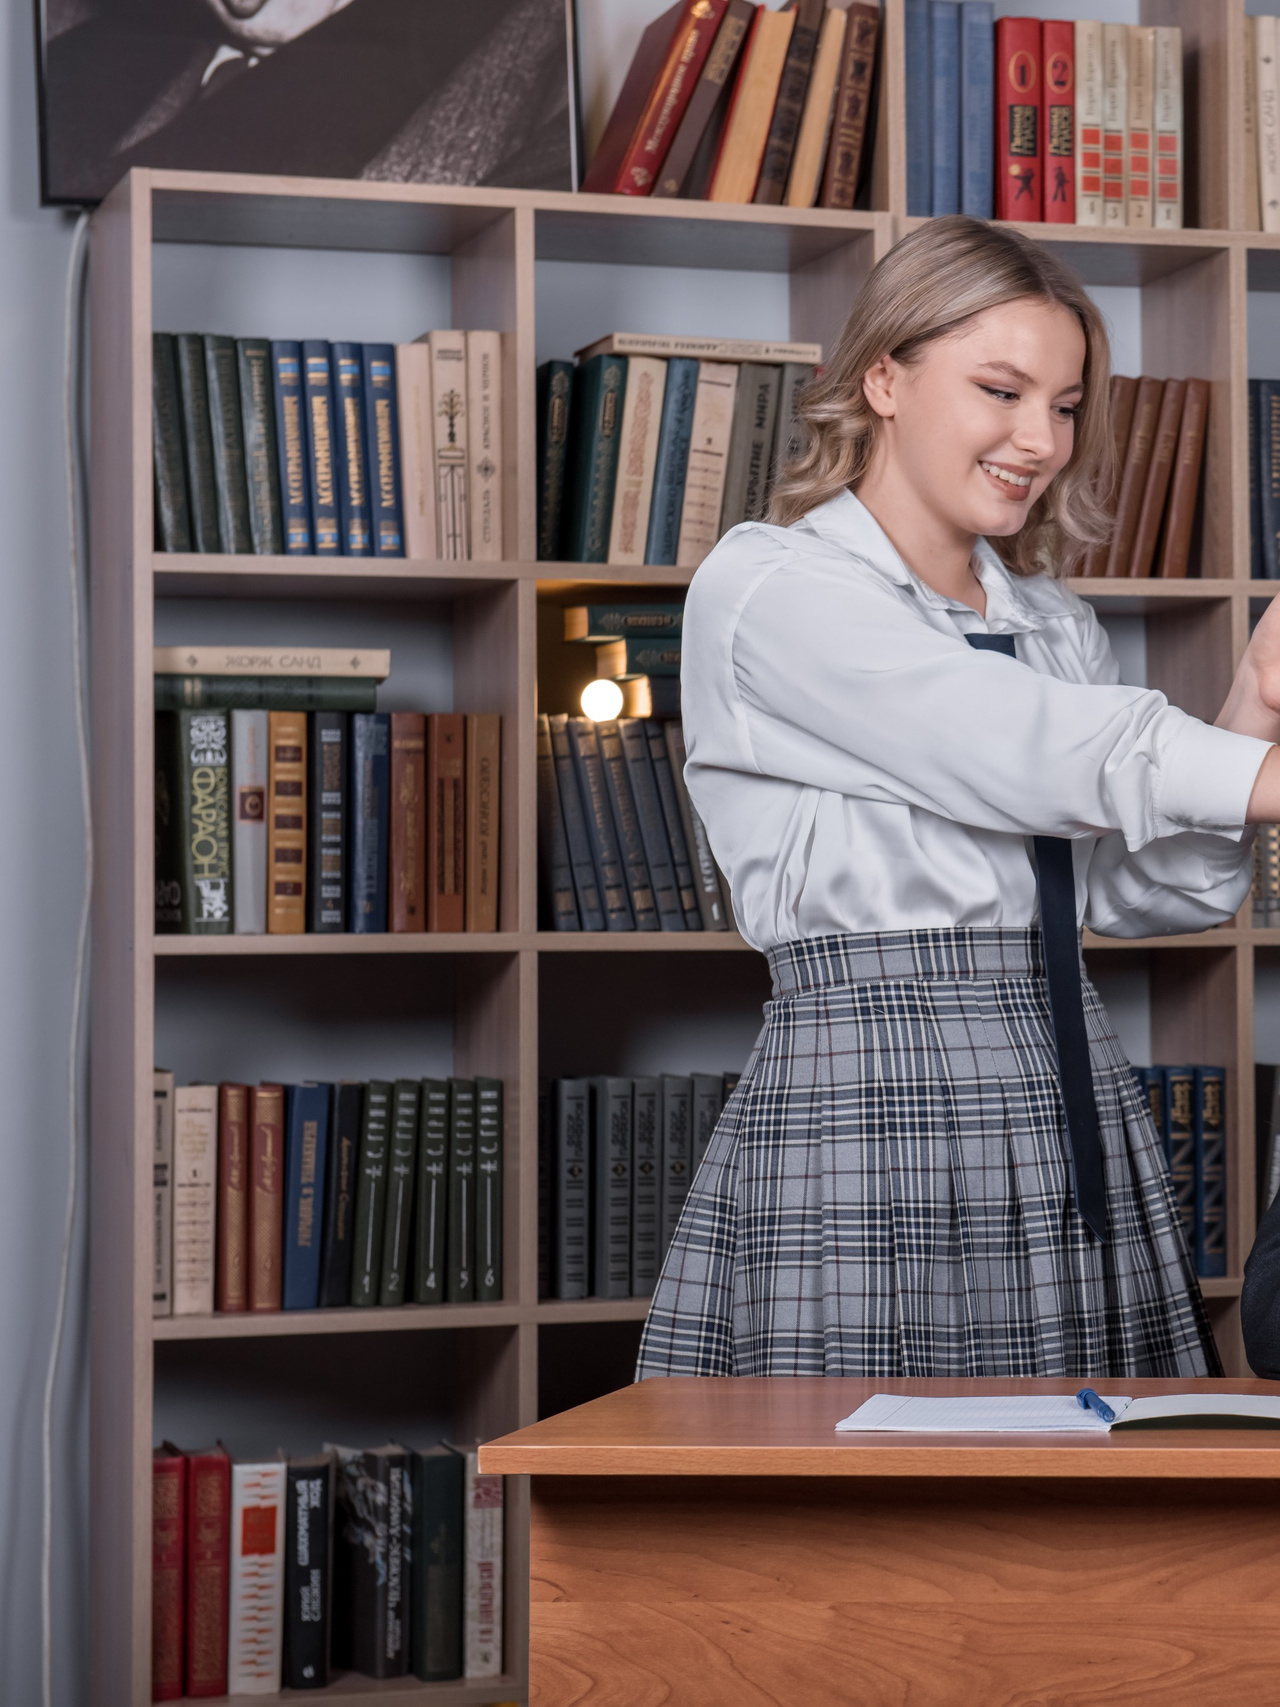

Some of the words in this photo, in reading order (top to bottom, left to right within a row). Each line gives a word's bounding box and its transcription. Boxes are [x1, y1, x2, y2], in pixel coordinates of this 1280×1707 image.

[1018, 64, 1027, 87] 1
[1051, 60, 1069, 87] 2
[1108, 205, 1119, 220] 3
[1135, 203, 1145, 218] 2
[225, 654, 274, 669] ЖОРЖ
[279, 655, 322, 669] САНД
[215, 767, 228, 837] БОЛЕСЛАВ
[191, 766, 217, 880] ФАРАОН
[217, 839, 230, 880] ПРУС
[362, 1274, 371, 1293] 1
[387, 1272, 399, 1292] 2
[426, 1271, 437, 1290] 4
[484, 1268, 495, 1287] 6
[309, 1478, 324, 1509] ХОД
[295, 1479, 309, 1567] ШАХМАТНЫЙ
